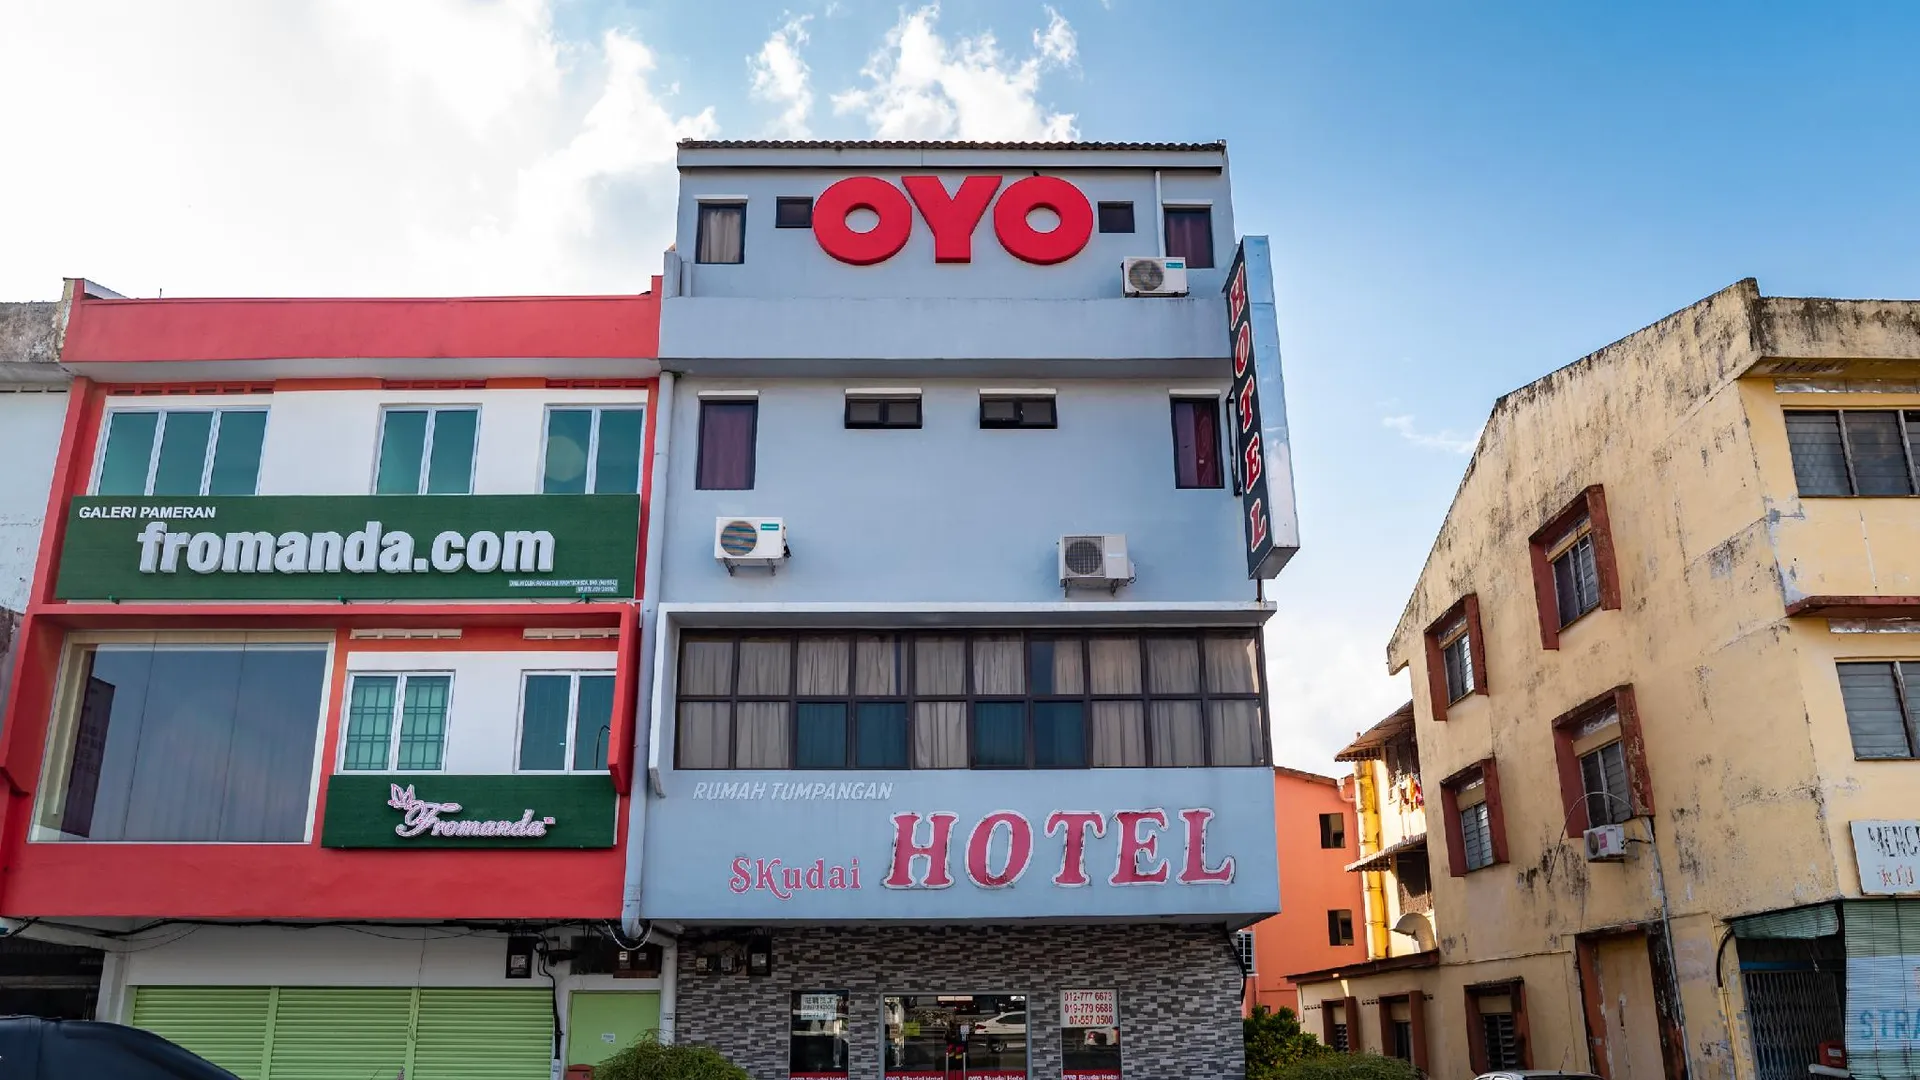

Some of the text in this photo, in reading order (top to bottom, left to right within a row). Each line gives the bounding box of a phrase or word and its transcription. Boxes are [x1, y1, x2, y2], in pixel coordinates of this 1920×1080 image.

[812, 175, 1094, 265] OYO
[1229, 261, 1267, 552] HOTEL
[79, 506, 217, 519] GALERI PAMERAN
[137, 521, 555, 574] fromanda.com
[693, 782, 894, 801] RUMAH TUMPANGAN
[395, 801, 547, 838] Fromanda
[881, 808, 1235, 889] HOTEL
[1095, 1015, 1114, 1025] 0500
